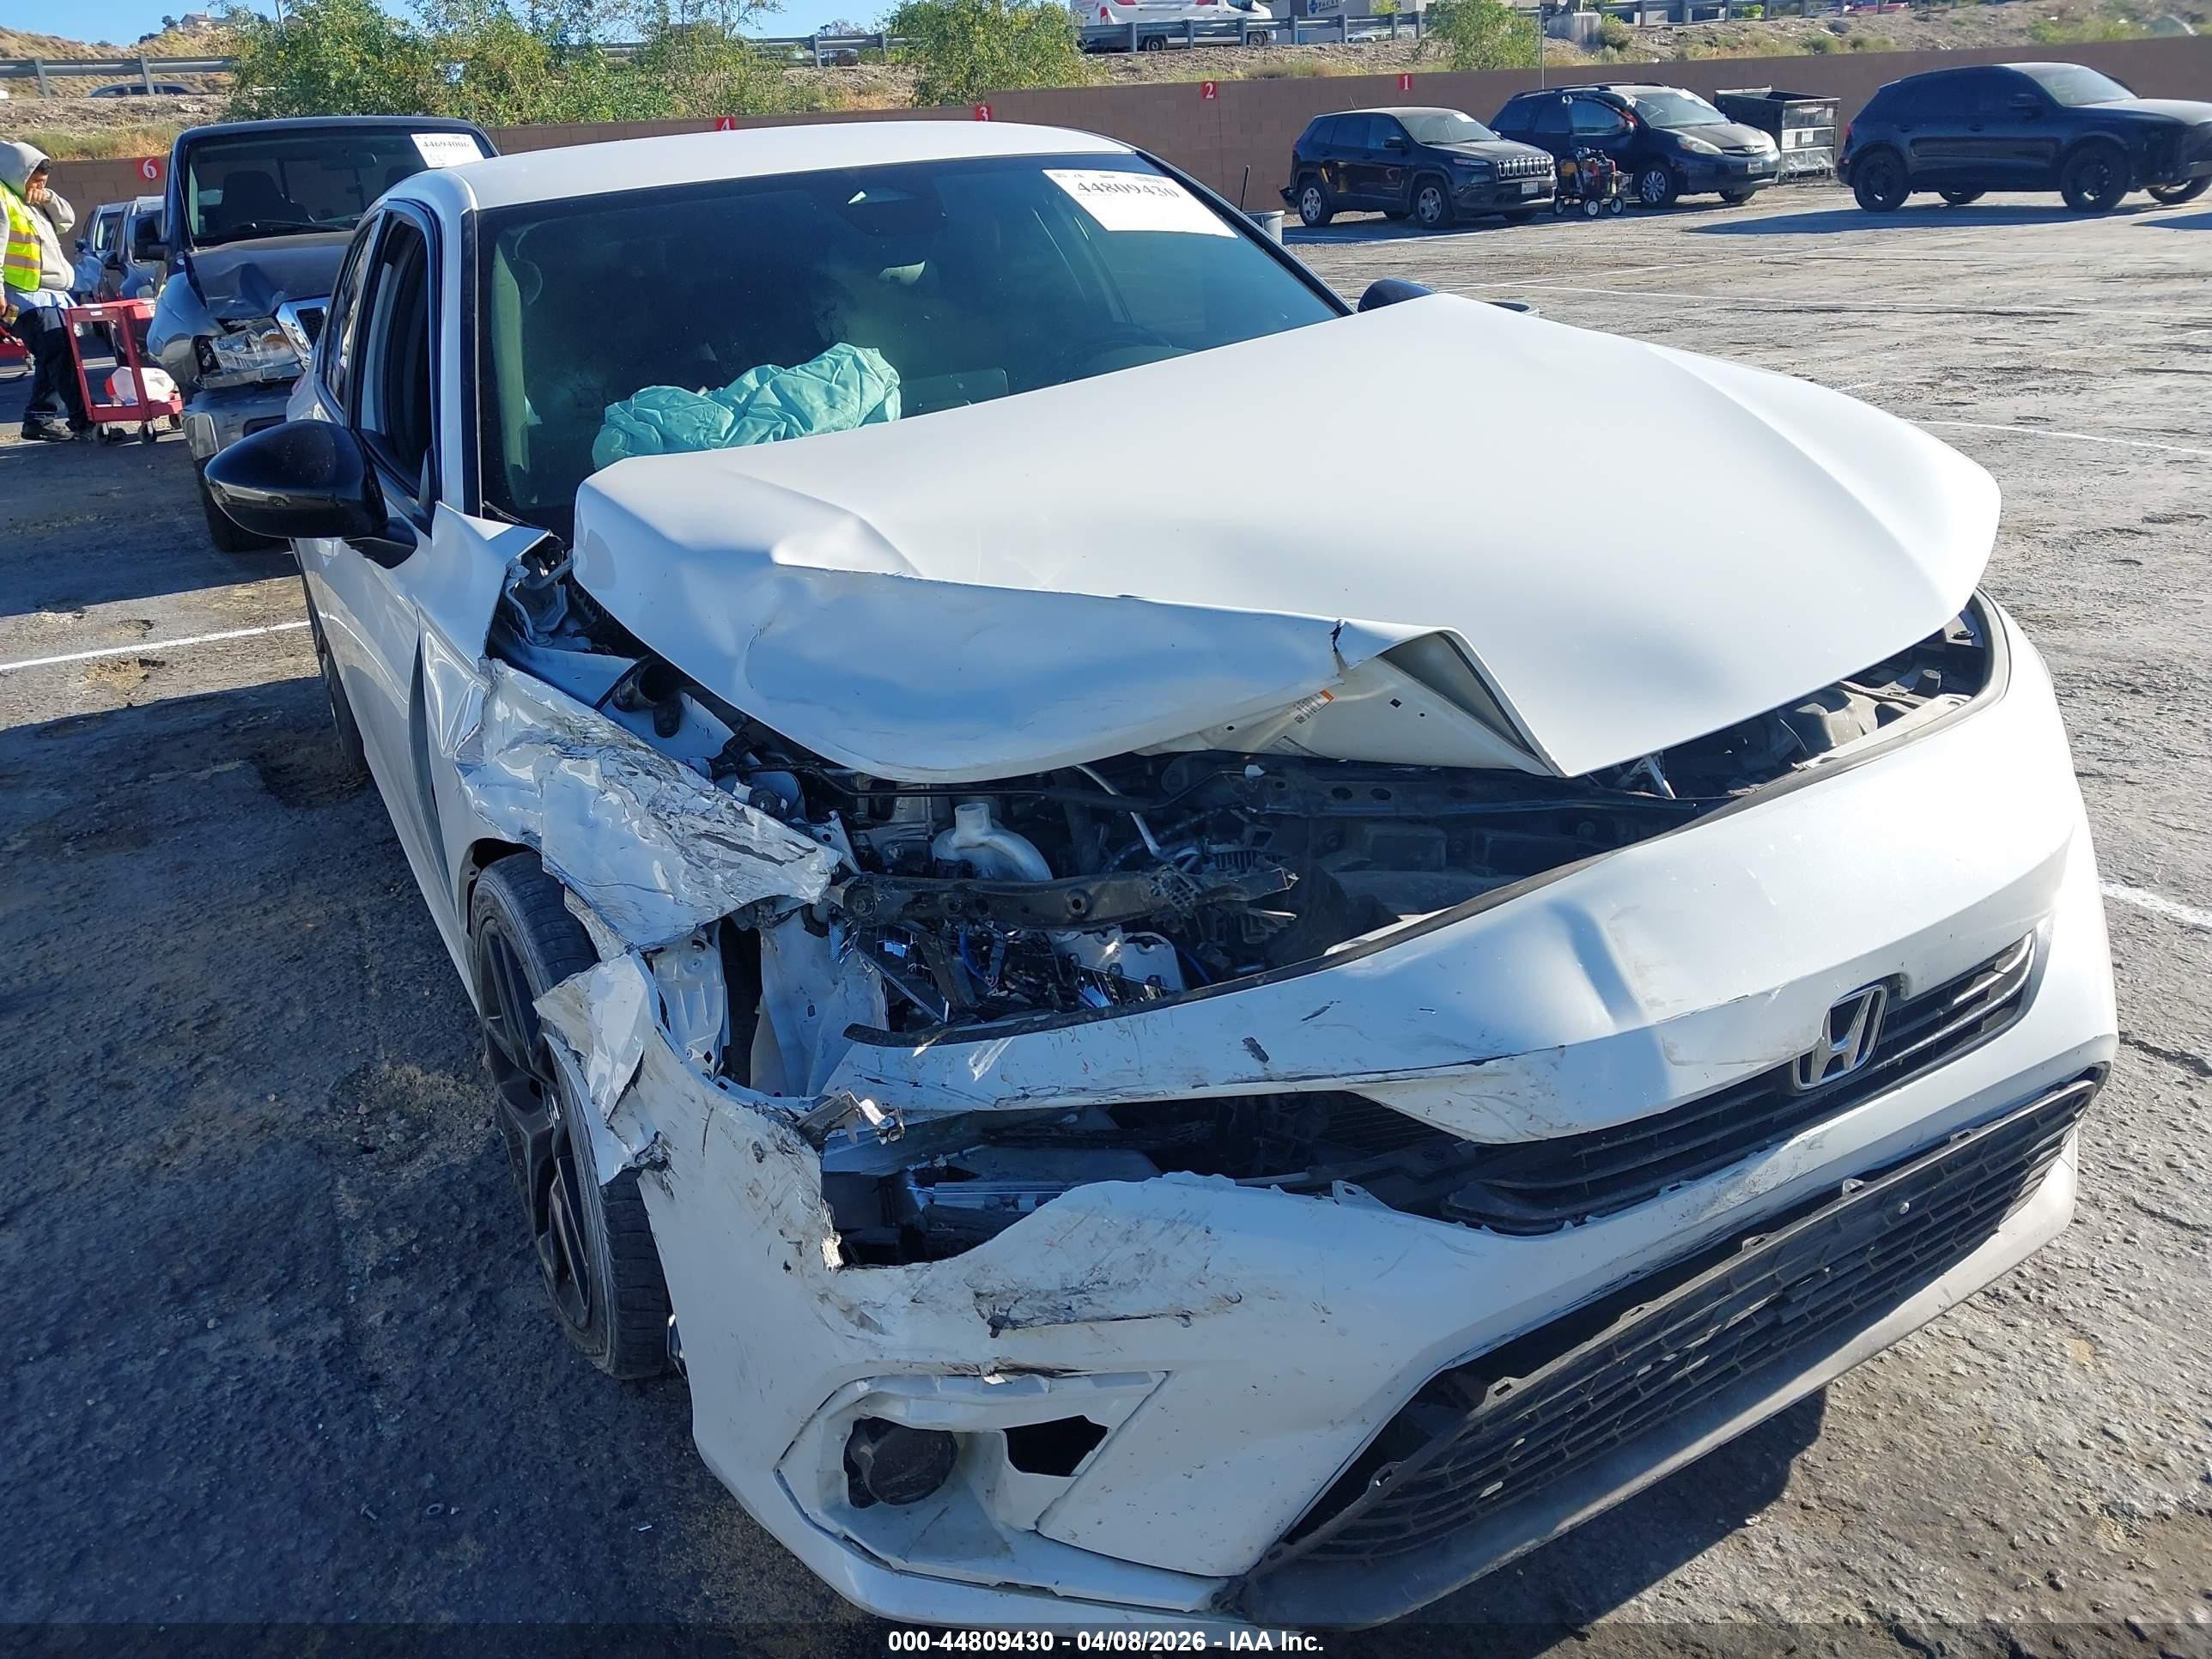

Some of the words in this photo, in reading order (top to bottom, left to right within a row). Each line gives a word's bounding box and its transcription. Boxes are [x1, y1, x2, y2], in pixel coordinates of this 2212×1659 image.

[1206, 82, 1214, 99] 2
[1404, 75, 1409, 90] 1
[979, 106, 988, 122] 3
[143, 158, 157, 179] 6
[1078, 182, 1180, 198] 44809430
